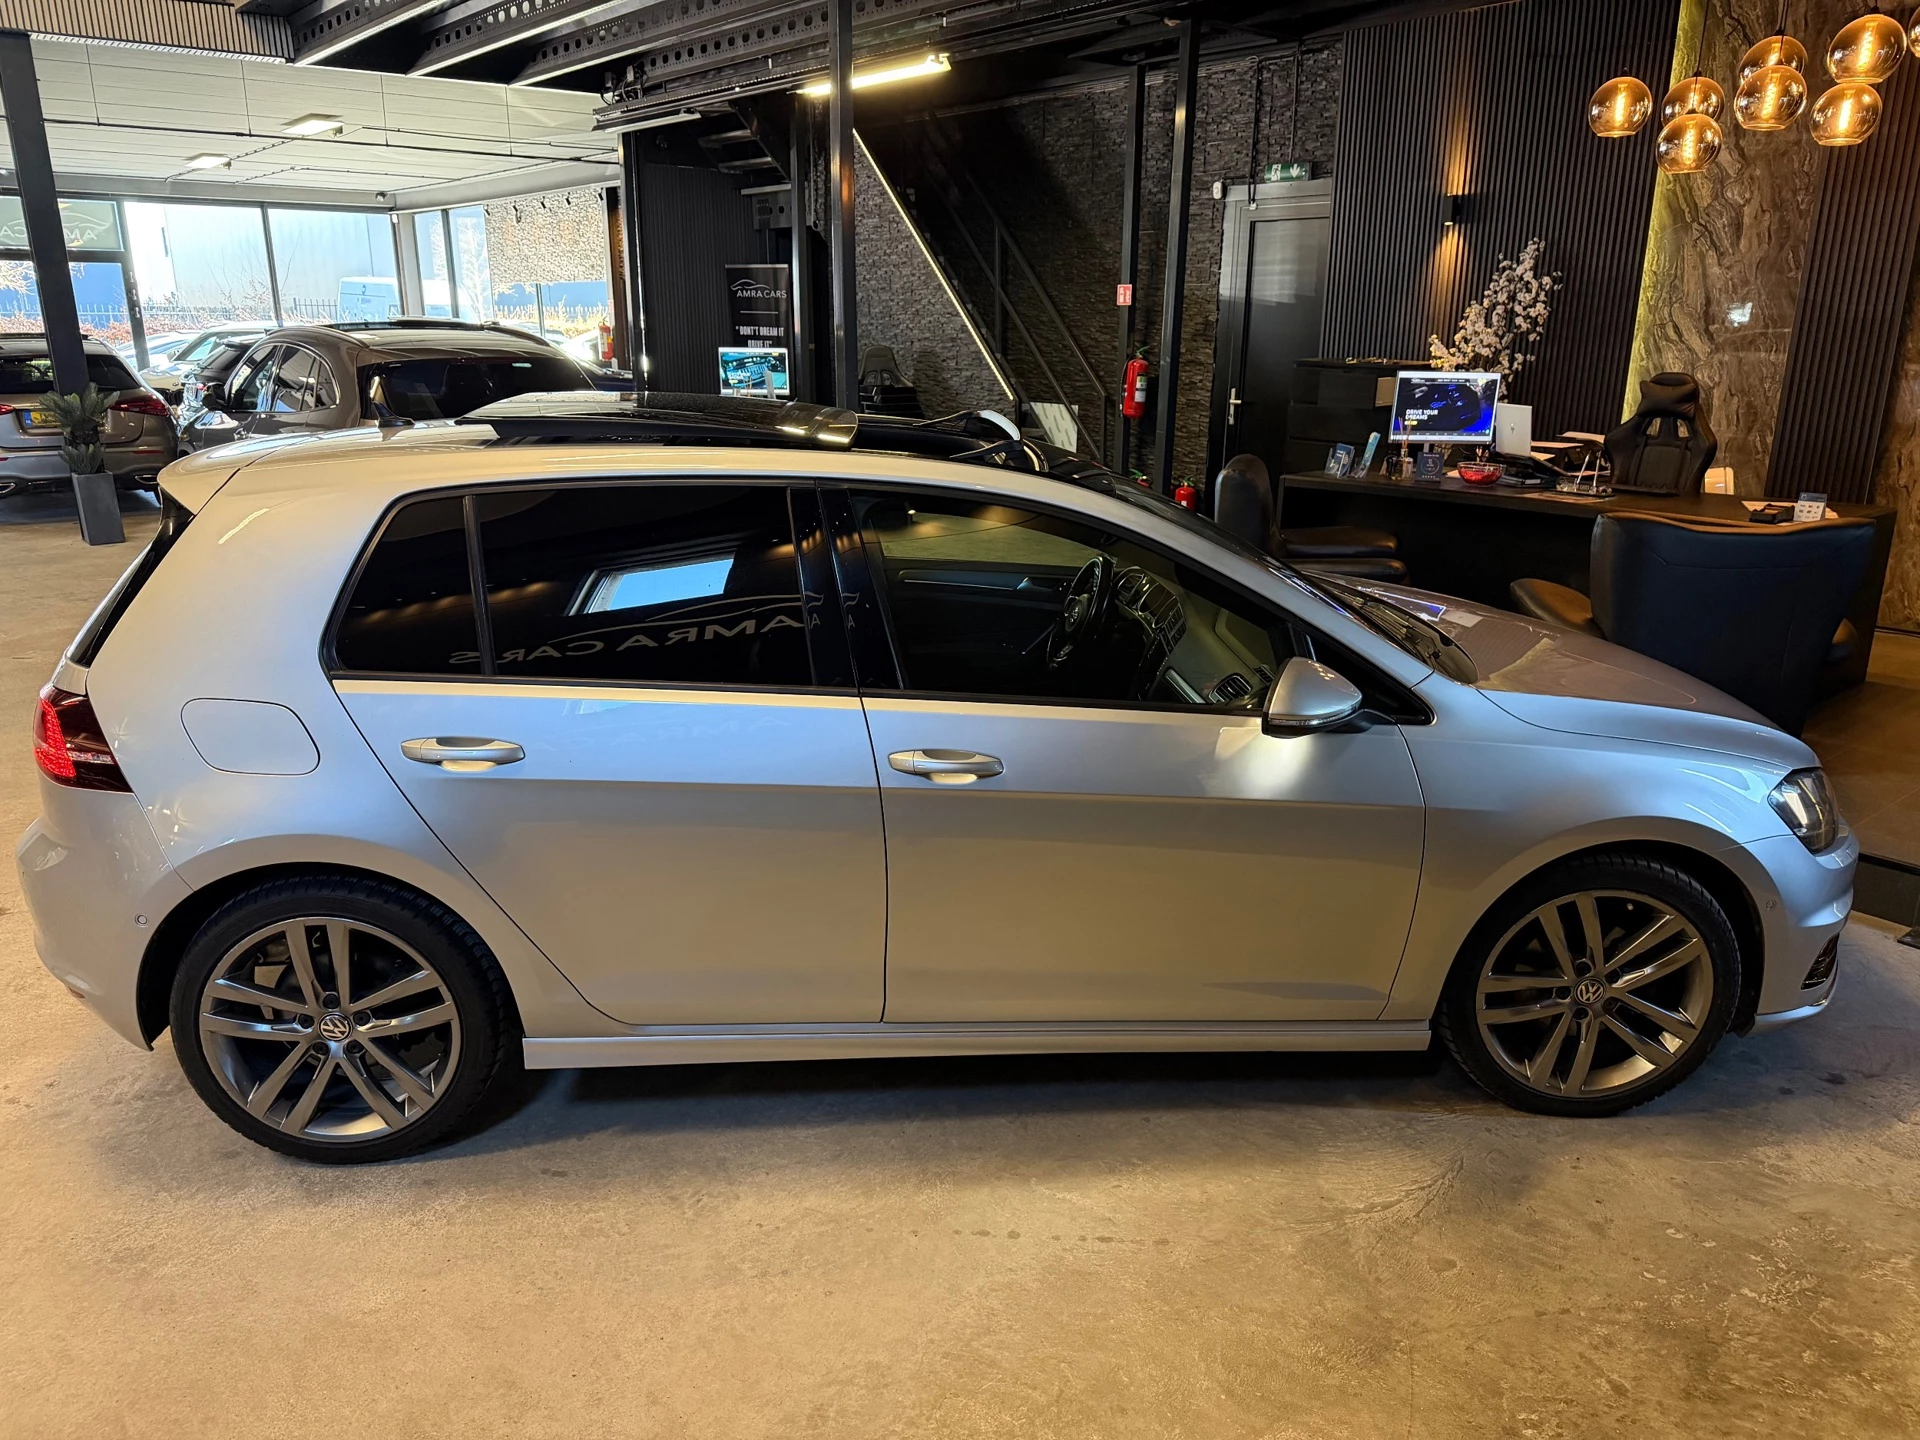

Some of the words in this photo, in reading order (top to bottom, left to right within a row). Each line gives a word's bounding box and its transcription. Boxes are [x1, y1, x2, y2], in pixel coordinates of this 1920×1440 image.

[736, 290, 763, 298] AMRA
[763, 289, 787, 299] CARS
[759, 326, 778, 337] DREAM
[778, 327, 784, 337] IT
[747, 339, 764, 348] DRIVE
